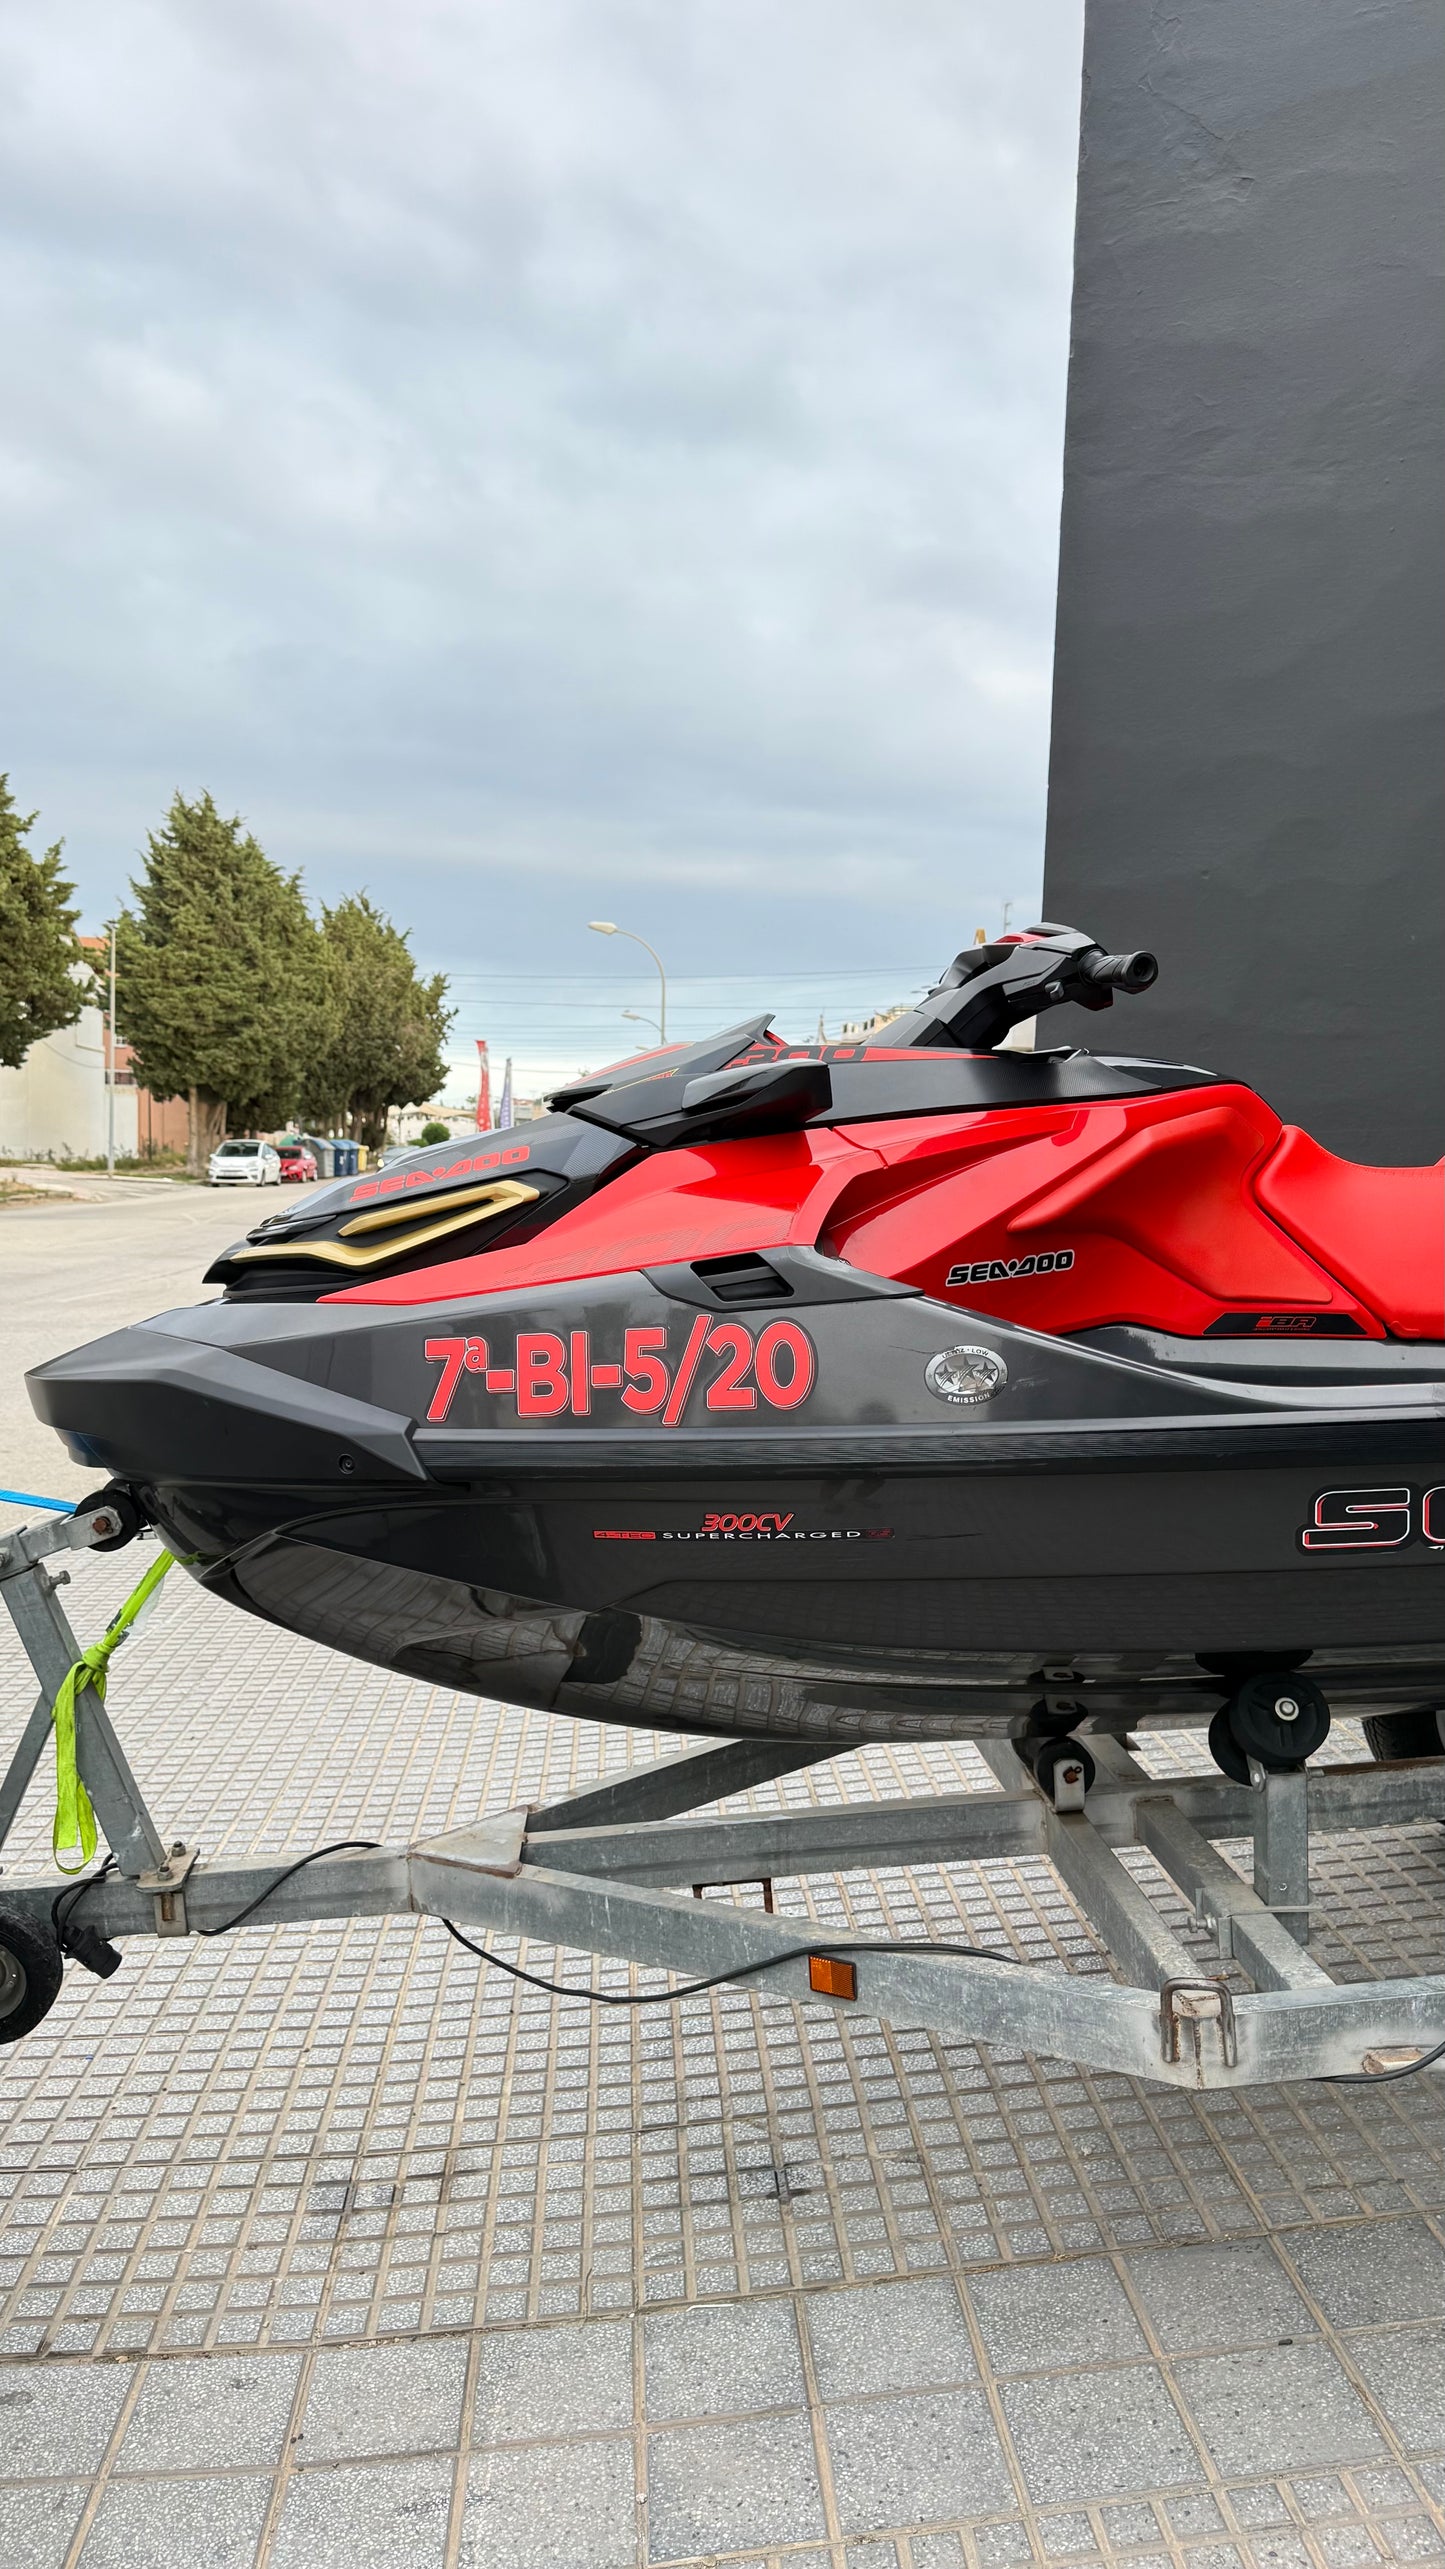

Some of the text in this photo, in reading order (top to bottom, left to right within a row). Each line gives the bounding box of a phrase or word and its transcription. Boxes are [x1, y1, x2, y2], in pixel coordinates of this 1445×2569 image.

[947, 1392, 990, 1403] EMISSION
[702, 1513, 795, 1532] 300CV
[1302, 1486, 1445, 1549] S
[662, 1530, 861, 1540] SUPERCHARGED
